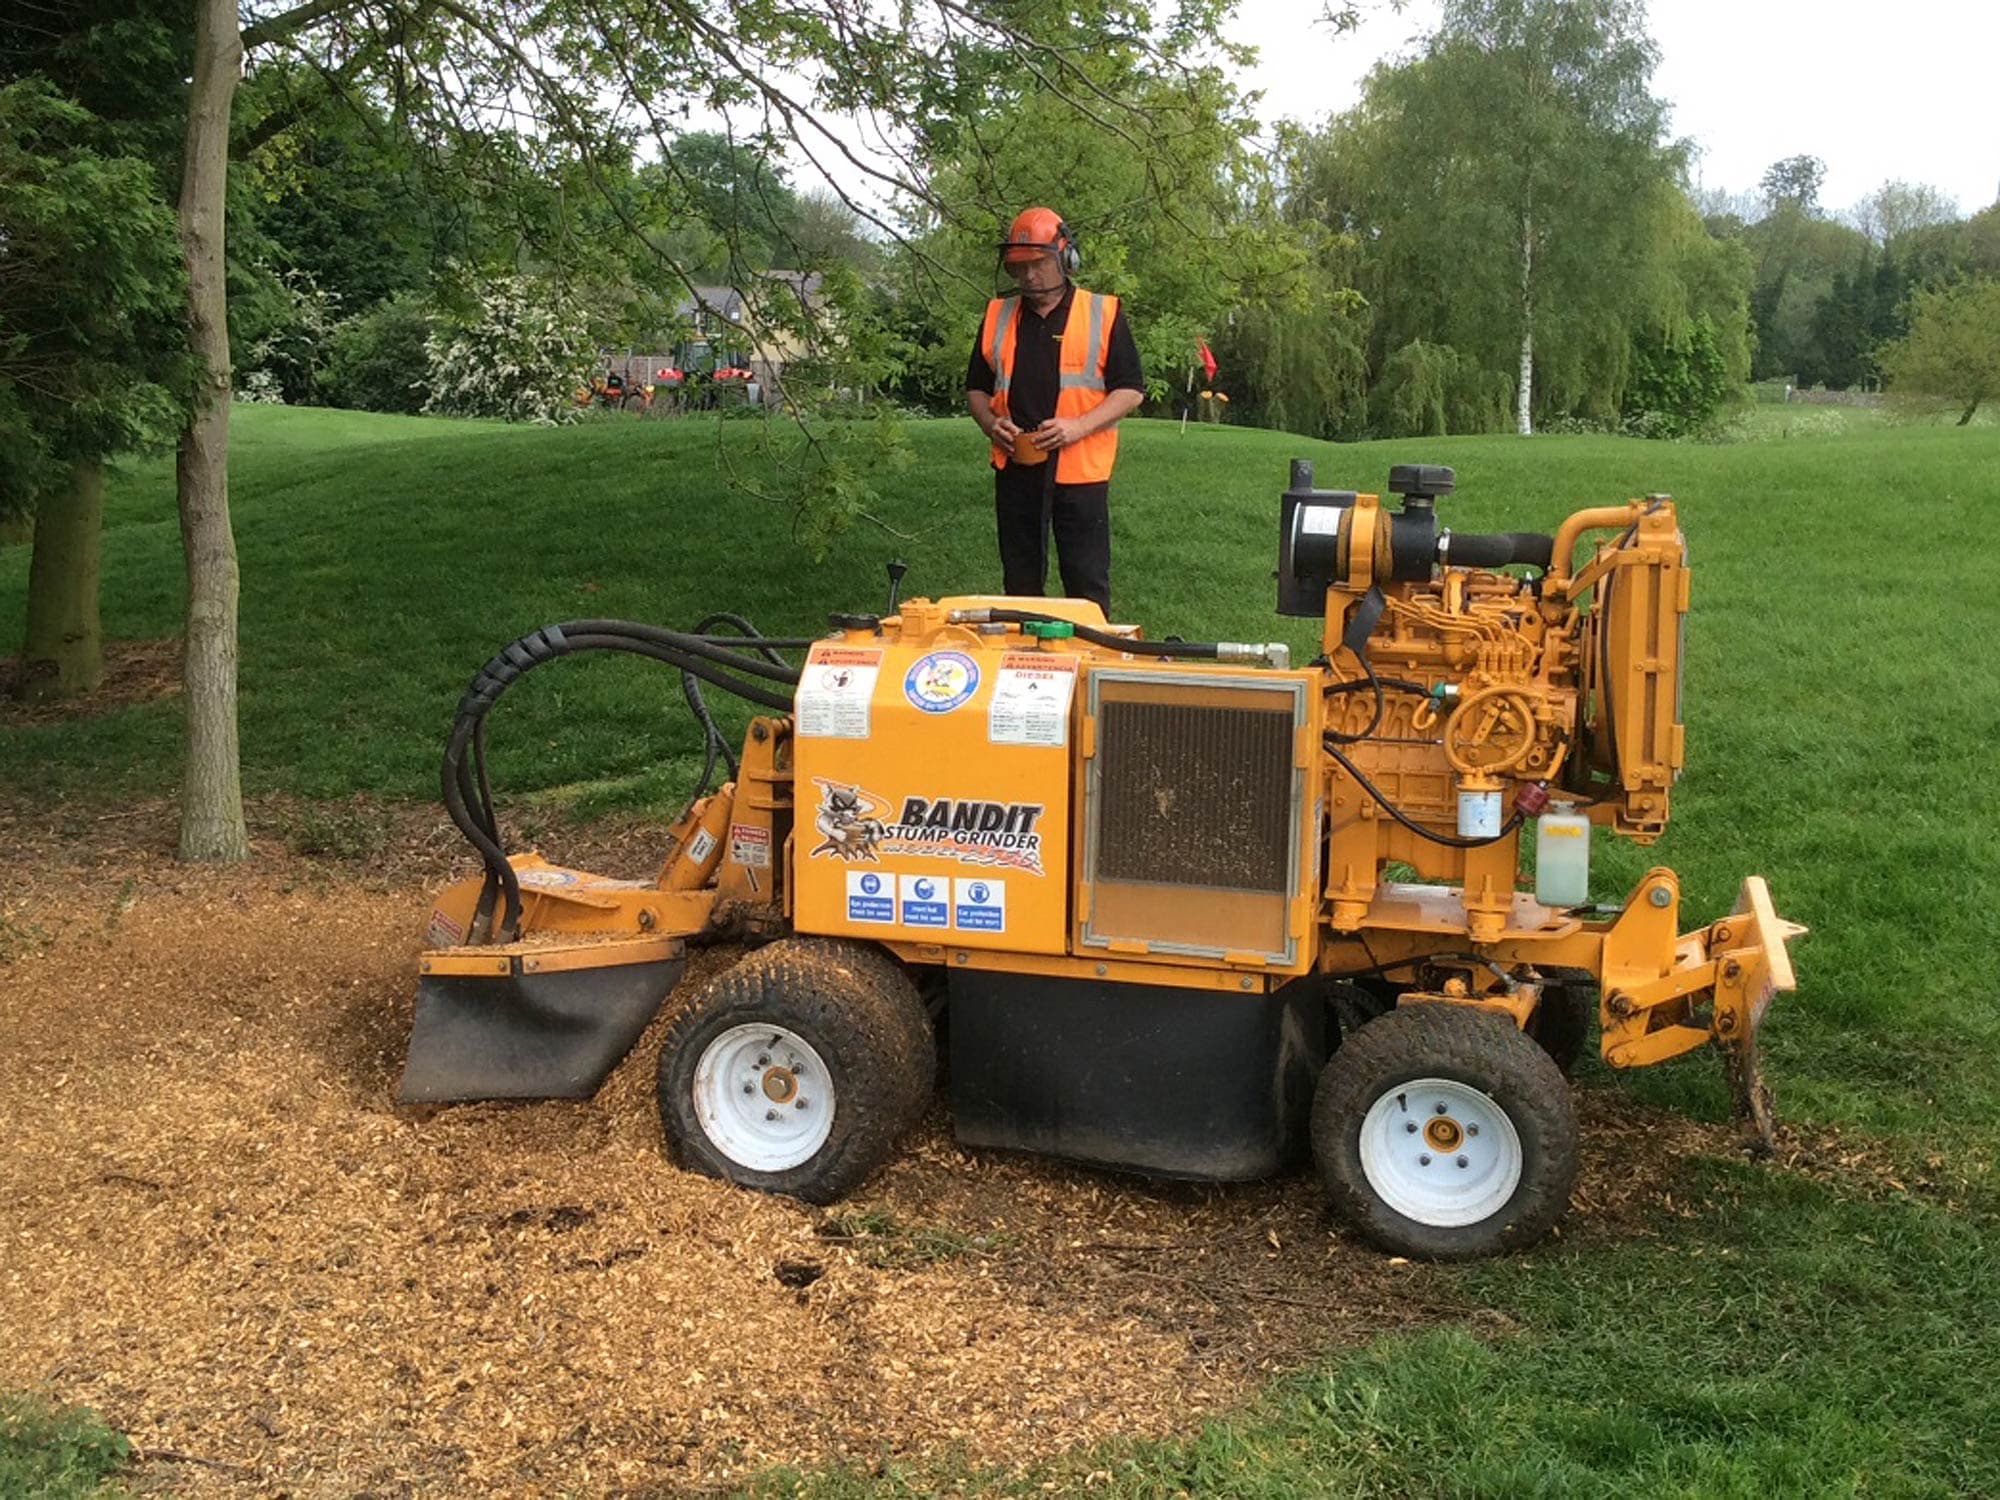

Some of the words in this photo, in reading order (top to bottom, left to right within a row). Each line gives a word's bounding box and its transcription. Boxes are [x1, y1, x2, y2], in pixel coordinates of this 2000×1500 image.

[900, 798, 1042, 833] BANDIT
[884, 826, 949, 842] STUMP
[954, 831, 1039, 850] GRINDER
